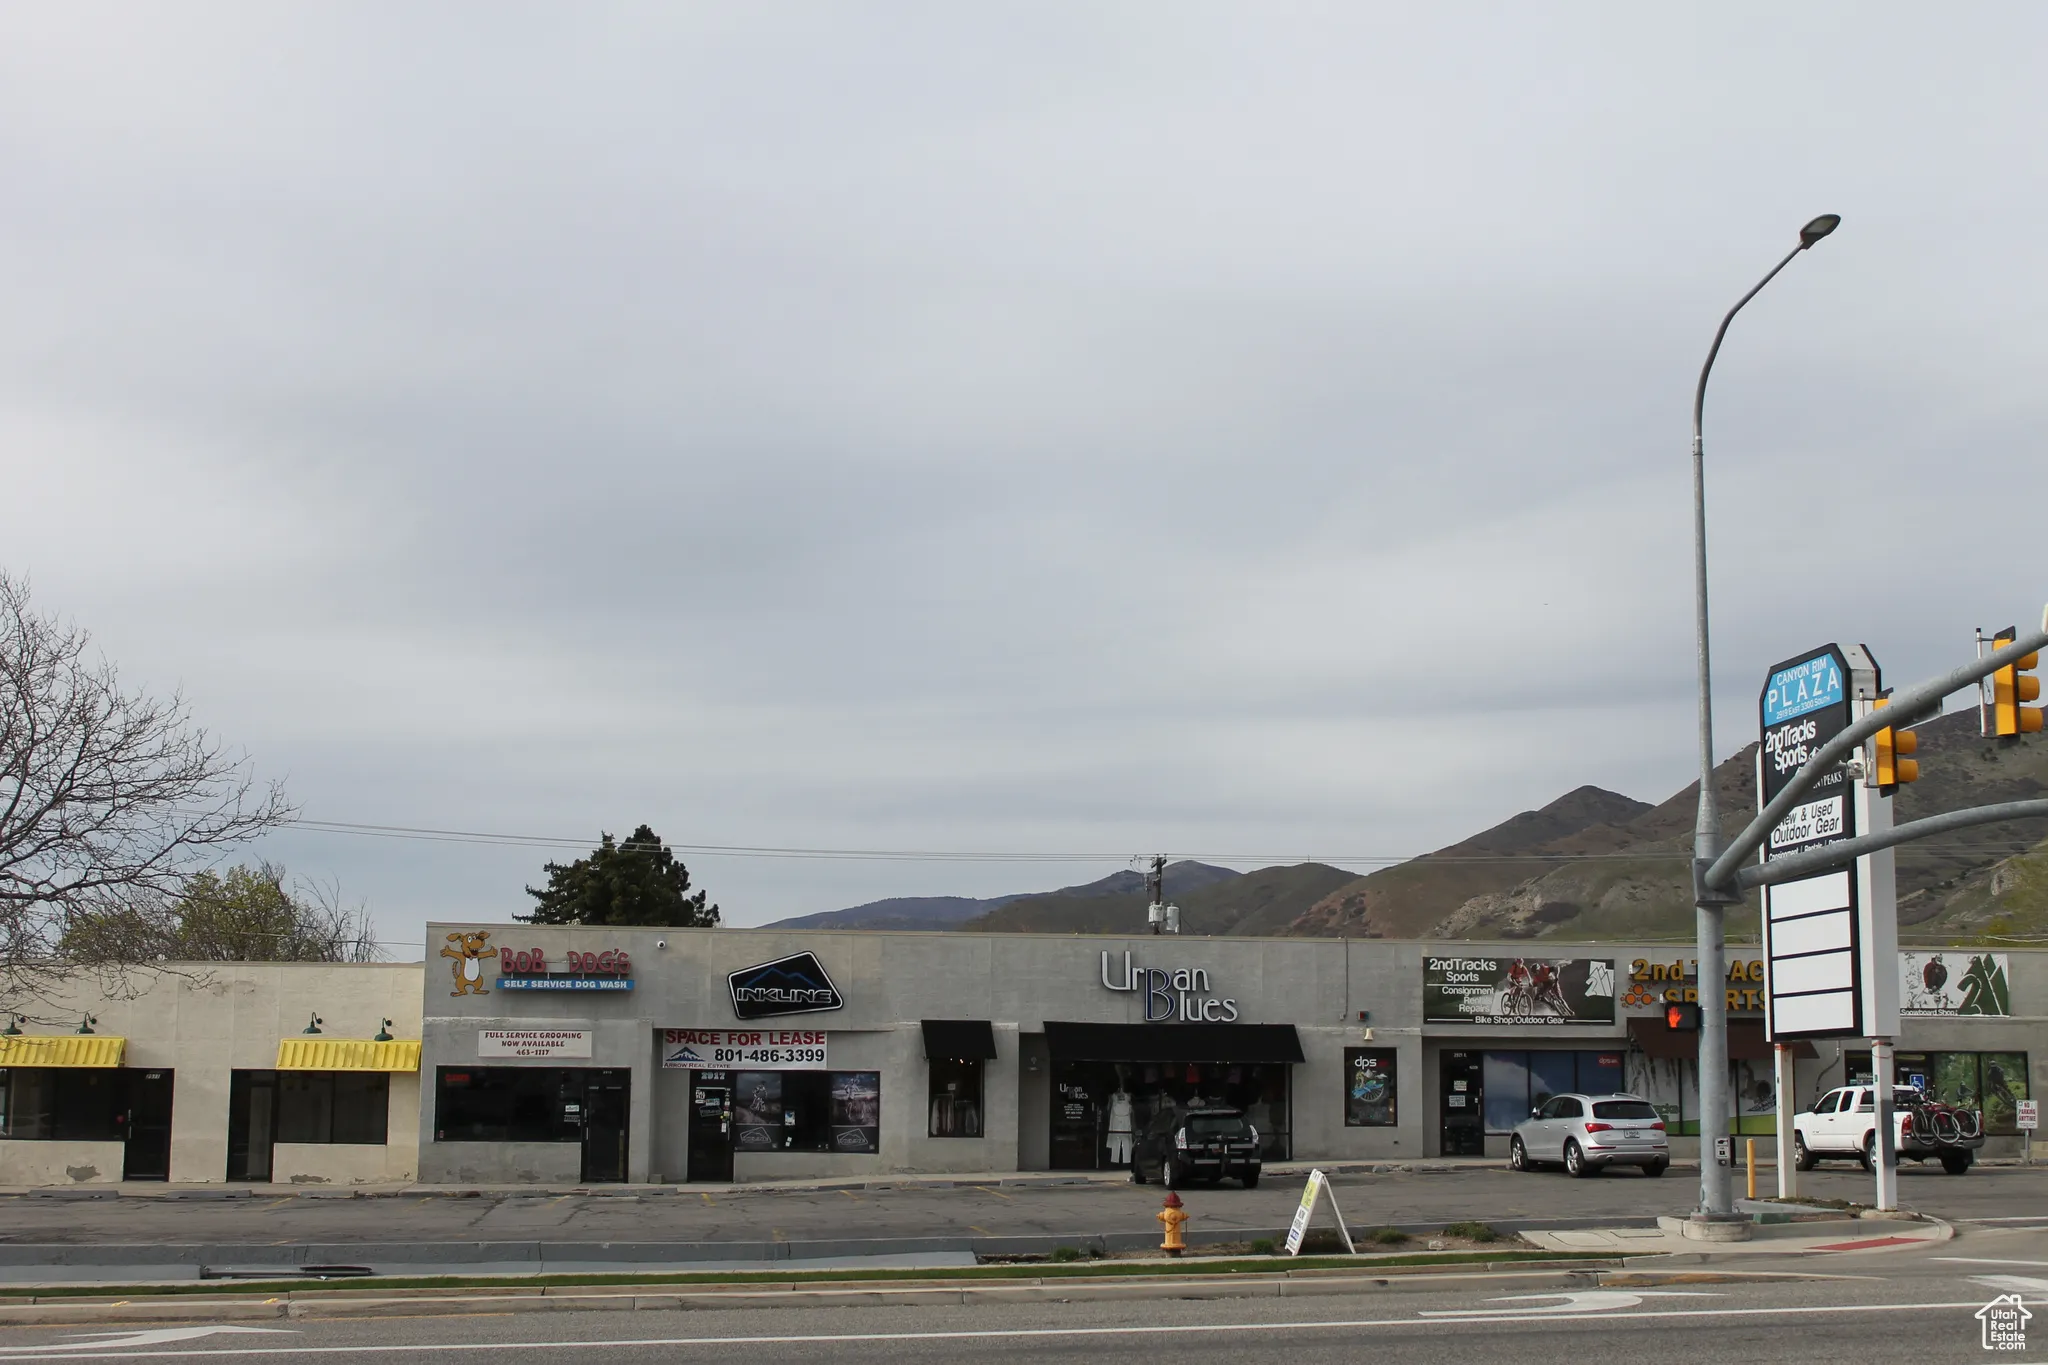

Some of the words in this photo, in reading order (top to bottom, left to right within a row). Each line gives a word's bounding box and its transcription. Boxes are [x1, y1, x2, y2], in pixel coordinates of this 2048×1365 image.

[1777, 664, 1809, 686] CANYON
[1812, 658, 1827, 672] RIM
[1768, 668, 1840, 712] PLAZA
[1765, 720, 1816, 754] 2ndTracks
[1774, 743, 1808, 774] Sports
[1800, 807, 1807, 822] &
[1811, 801, 1833, 819] Used
[1773, 824, 1811, 844] Outdoor
[1815, 817, 1840, 834] Gear
[500, 948, 546, 973] BOB
[567, 949, 631, 973] DOG'S
[1429, 959, 1497, 972] 2ndTracks
[1446, 972, 1480, 983] Sports
[1632, 959, 1684, 981] 2nd
[504, 980, 527, 988] SELF
[531, 980, 572, 989] SERVICE
[575, 981, 596, 989] DOG
[600, 981, 627, 989] WASH
[1441, 986, 1494, 996] Consignment
[736, 987, 832, 1004] INKLINE
[1459, 1004, 1490, 1014] Repairs
[1475, 1016, 1491, 1024] Bike
[1546, 1017, 1565, 1025] Gear
[665, 1031, 721, 1045] SPACE
[727, 1032, 762, 1046] FOR
[769, 1032, 825, 1046] LEASE
[714, 1049, 825, 1063] 801-486-3399
[1354, 1055, 1377, 1070] dps
